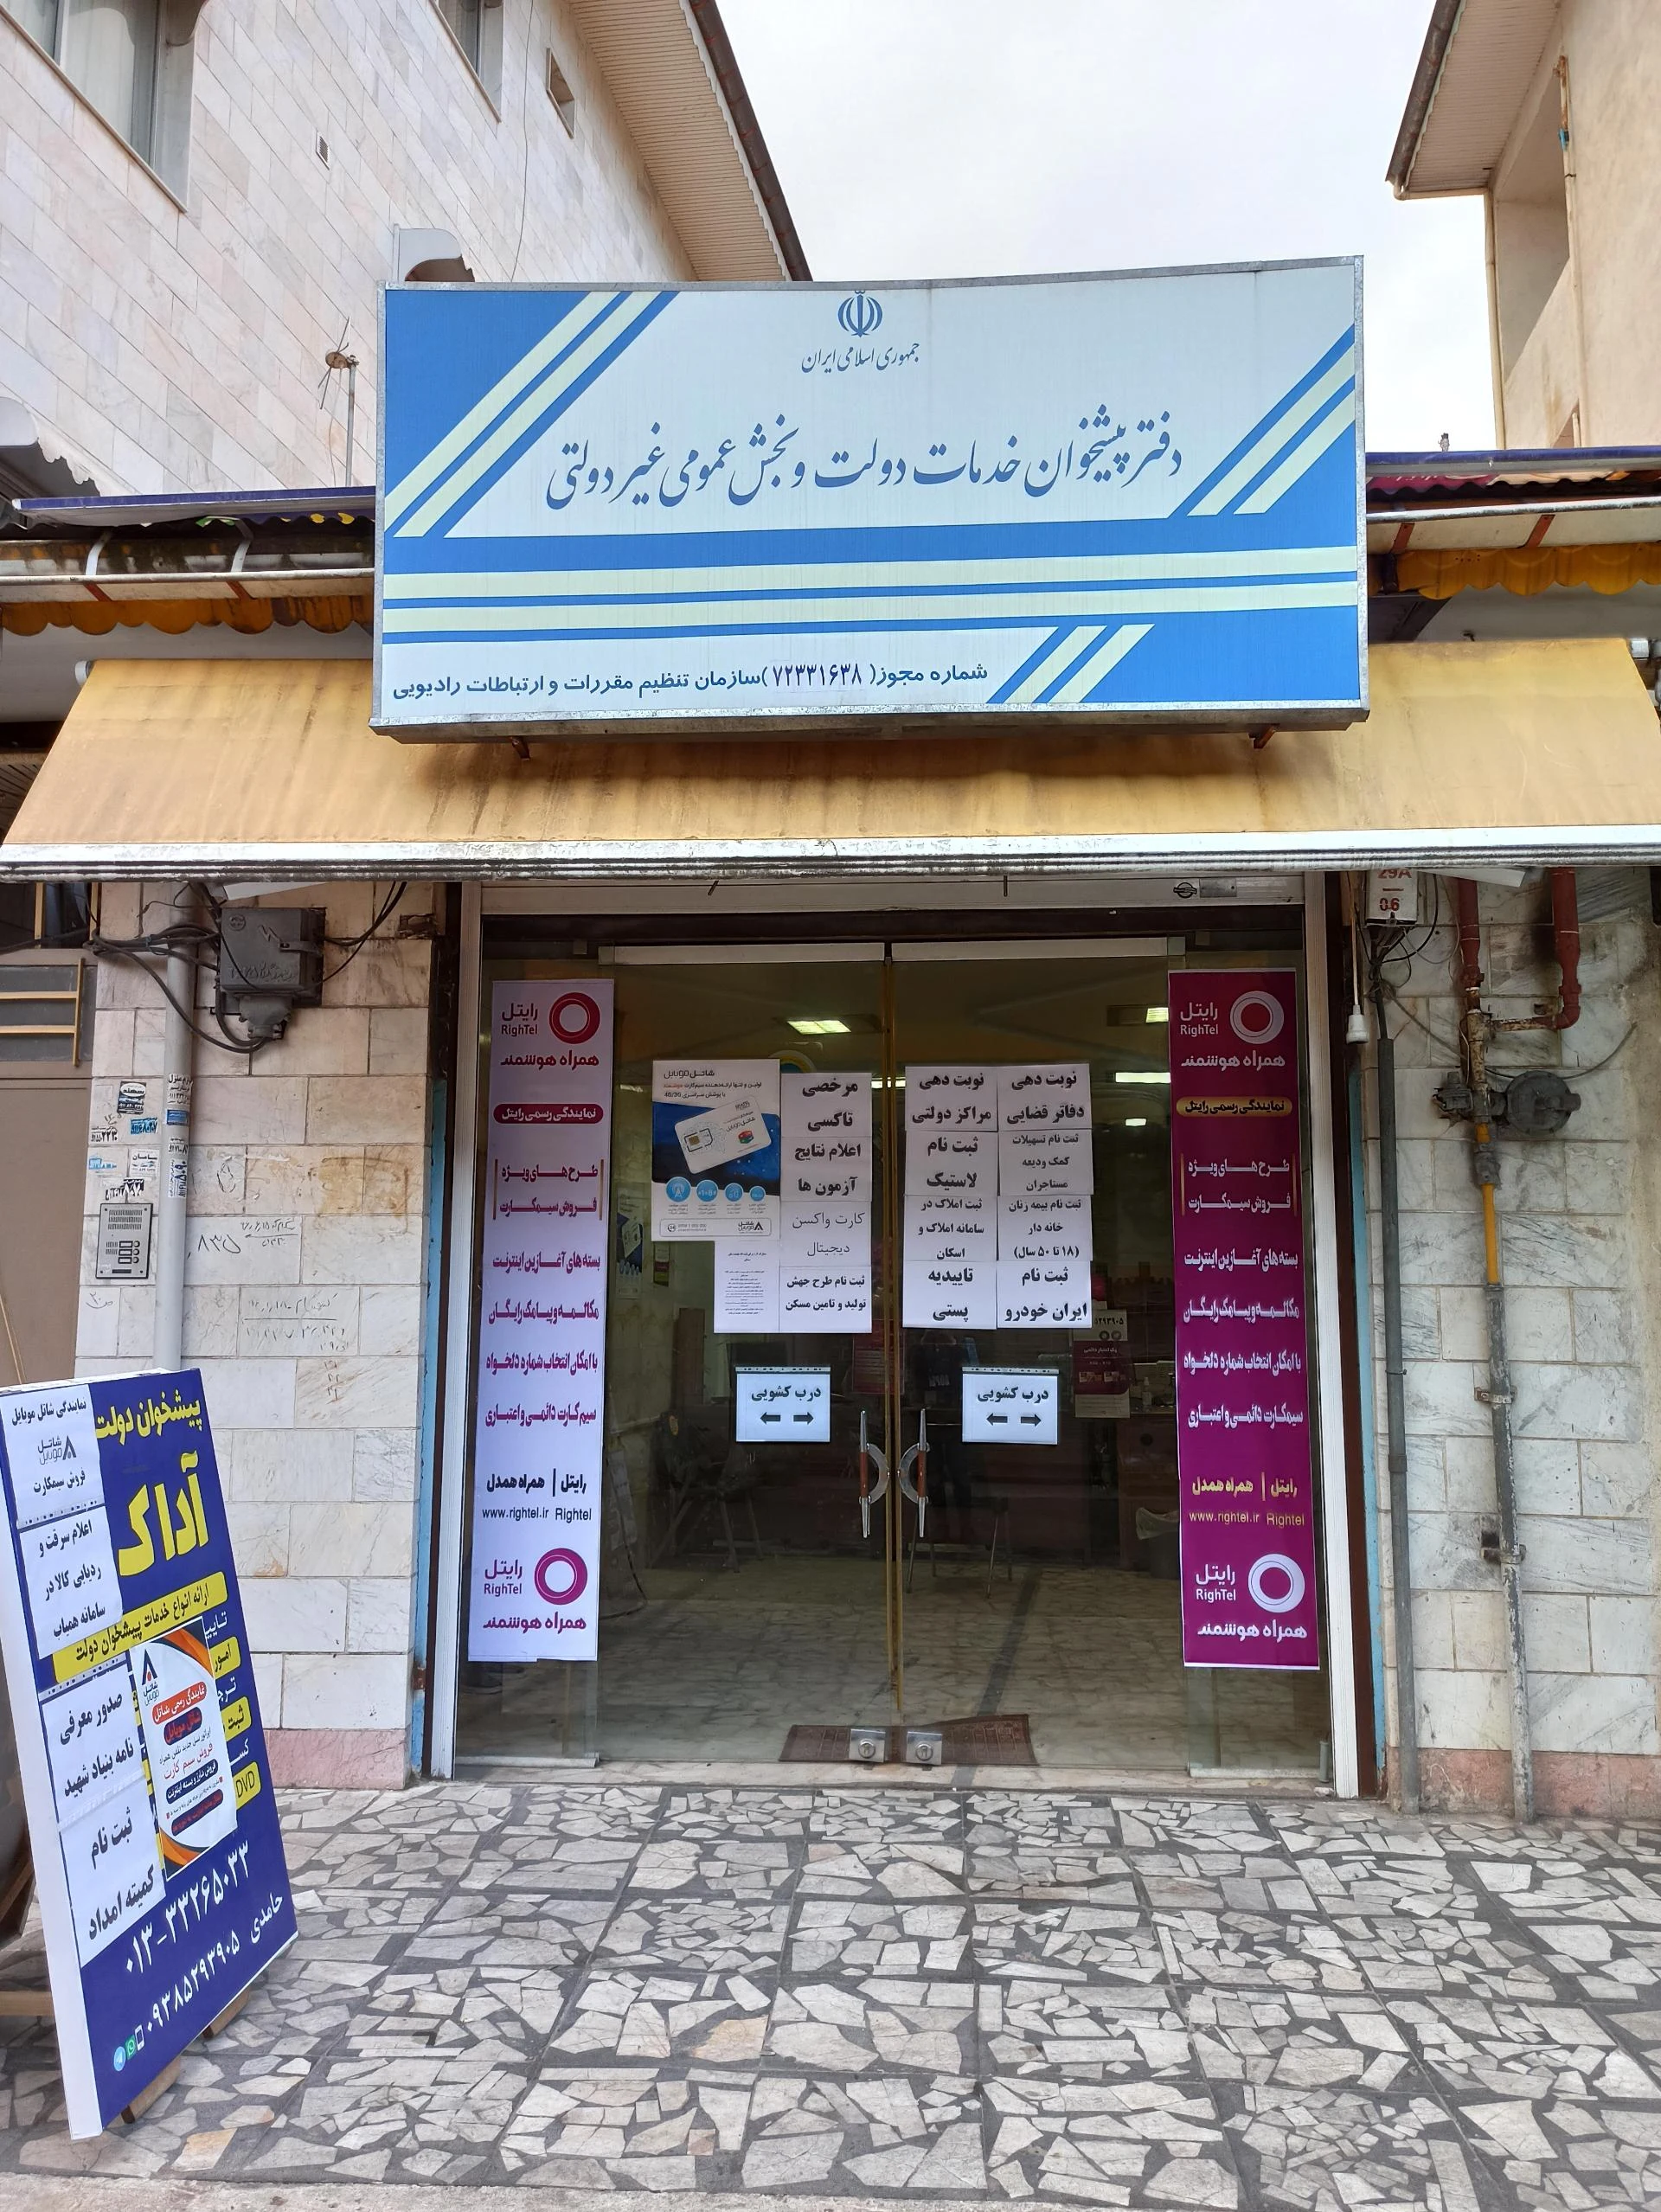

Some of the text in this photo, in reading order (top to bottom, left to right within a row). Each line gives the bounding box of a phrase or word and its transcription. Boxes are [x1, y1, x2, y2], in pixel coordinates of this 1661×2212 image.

[801, 342, 920, 374] جمهوری اسلامی ایران
[728, 414, 799, 506] بخش
[1024, 404, 1126, 497] پیشخوان
[1121, 411, 1182, 488] دفتر
[814, 439, 906, 487] دولت
[914, 435, 1021, 486] خدمات
[659, 439, 737, 508] عمومی
[791, 461, 805, 489] و
[564, 674, 633, 695] مقررات
[638, 672, 689, 697] تنظیم
[773, 664, 863, 687] ۷۲۳۳۱۶۳۸
[930, 664, 988, 685] شماره
[394, 676, 460, 700] رادیویی
[467, 675, 545, 696] ارتباطات
[548, 681, 558, 696] و
[502, 1003, 538, 1021] رایتل
[1180, 1002, 1218, 1022] رایتل
[501, 1024, 538, 1036] RighTel
[1180, 1024, 1218, 1037] RighTel
[501, 1050, 600, 1071] همراه هوشمند
[1181, 1049, 1286, 1072] همراه هوشمند
[802, 1078, 858, 1097] مرخصی
[920, 1073, 984, 1090] نوبت دهی
[1011, 1070, 1077, 1091] نوبت دهی
[553, 1106, 596, 1121] نمایندگی
[808, 1112, 853, 1132] تاکسی
[955, 1106, 991, 1125] مراکز
[1007, 1104, 1085, 1125] دفاتر قضایی
[795, 1143, 861, 1161] اعلام نتایج
[927, 1136, 978, 1157] ثبت نام
[502, 1164, 529, 1182] ویژه
[568, 1164, 598, 1182] طرح
[927, 1172, 978, 1191] لاستیک
[815, 1176, 857, 1196] آزمون
[559, 1197, 597, 1217] فروش
[792, 1211, 865, 1229] کارت واکسن
[807, 1241, 850, 1257] دیجیتال
[493, 1252, 524, 1273] اینترنت
[1022, 1266, 1068, 1286] ثبت نام
[933, 1304, 969, 1323] پستی
[1004, 1303, 1087, 1323] ایران خودرو
[752, 1385, 821, 1403] درب کشویی
[977, 1387, 1049, 1404] درب کشویی
[11, 1397, 87, 1427] نمایندگی شاتل موبایل
[96, 1389, 202, 1446] پیشخوان دولت
[67, 1469, 86, 1489] فروش
[486, 1473, 587, 1494] رایتل همراه همدل
[118, 1450, 209, 1576] آداک
[482, 1506, 592, 1523] www.rightel.ir Rightel
[1190, 1511, 1305, 1529] www.rightel.ir Rightel
[45, 1528, 70, 1551] سرقت
[72, 1519, 93, 1544] اعلام
[484, 1559, 523, 1580] رایتل
[1196, 1563, 1235, 1585] رایتل
[45, 1563, 102, 1600] ردیابی کالا در
[484, 1582, 523, 1597] RighTel
[1196, 1588, 1235, 1603] RighTel
[75, 1584, 209, 1662] ارائه انواع خدمات پیشخوان دولت
[80, 1603, 106, 1625] سامانه
[483, 1611, 587, 1634] همراه هوشمند
[1197, 1619, 1307, 1643] همراه هوشمند
[215, 1644, 232, 1672] امور
[96, 1694, 123, 1727] صدور
[60, 1708, 93, 1745] معرفی
[115, 1737, 134, 1766] نامه
[91, 1753, 113, 1780] بنیاد
[64, 1764, 88, 1798] شهید
[235, 1771, 255, 1798] DVD
[91, 1806, 132, 1869] ثبت نام
[88, 1863, 154, 1940] کمیته امداد
[250, 1892, 283, 1945] حامدی
